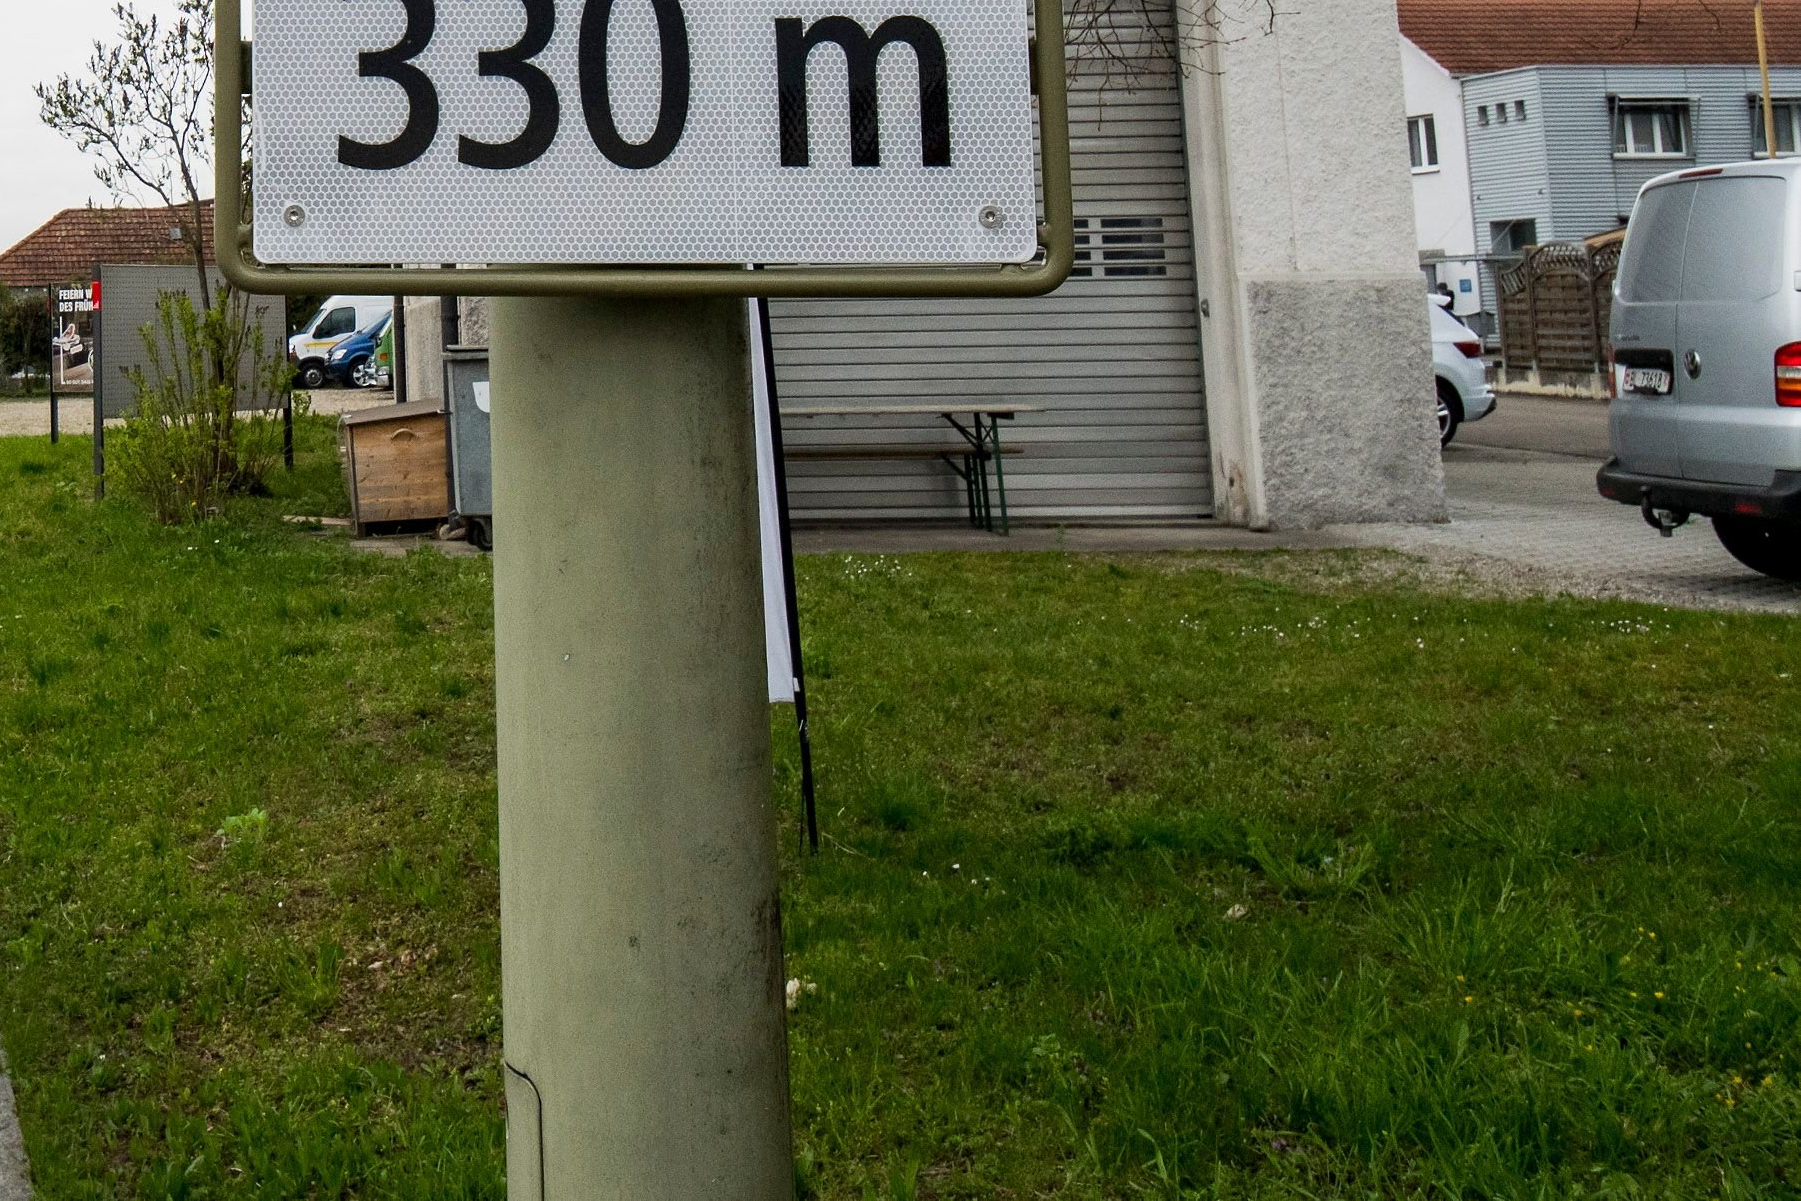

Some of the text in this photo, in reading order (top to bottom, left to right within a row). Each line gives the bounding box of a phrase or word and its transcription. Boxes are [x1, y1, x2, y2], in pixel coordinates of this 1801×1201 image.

[774, 14, 952, 168] m
[59, 289, 83, 299] FEIERN
[59, 301, 73, 312] DES
